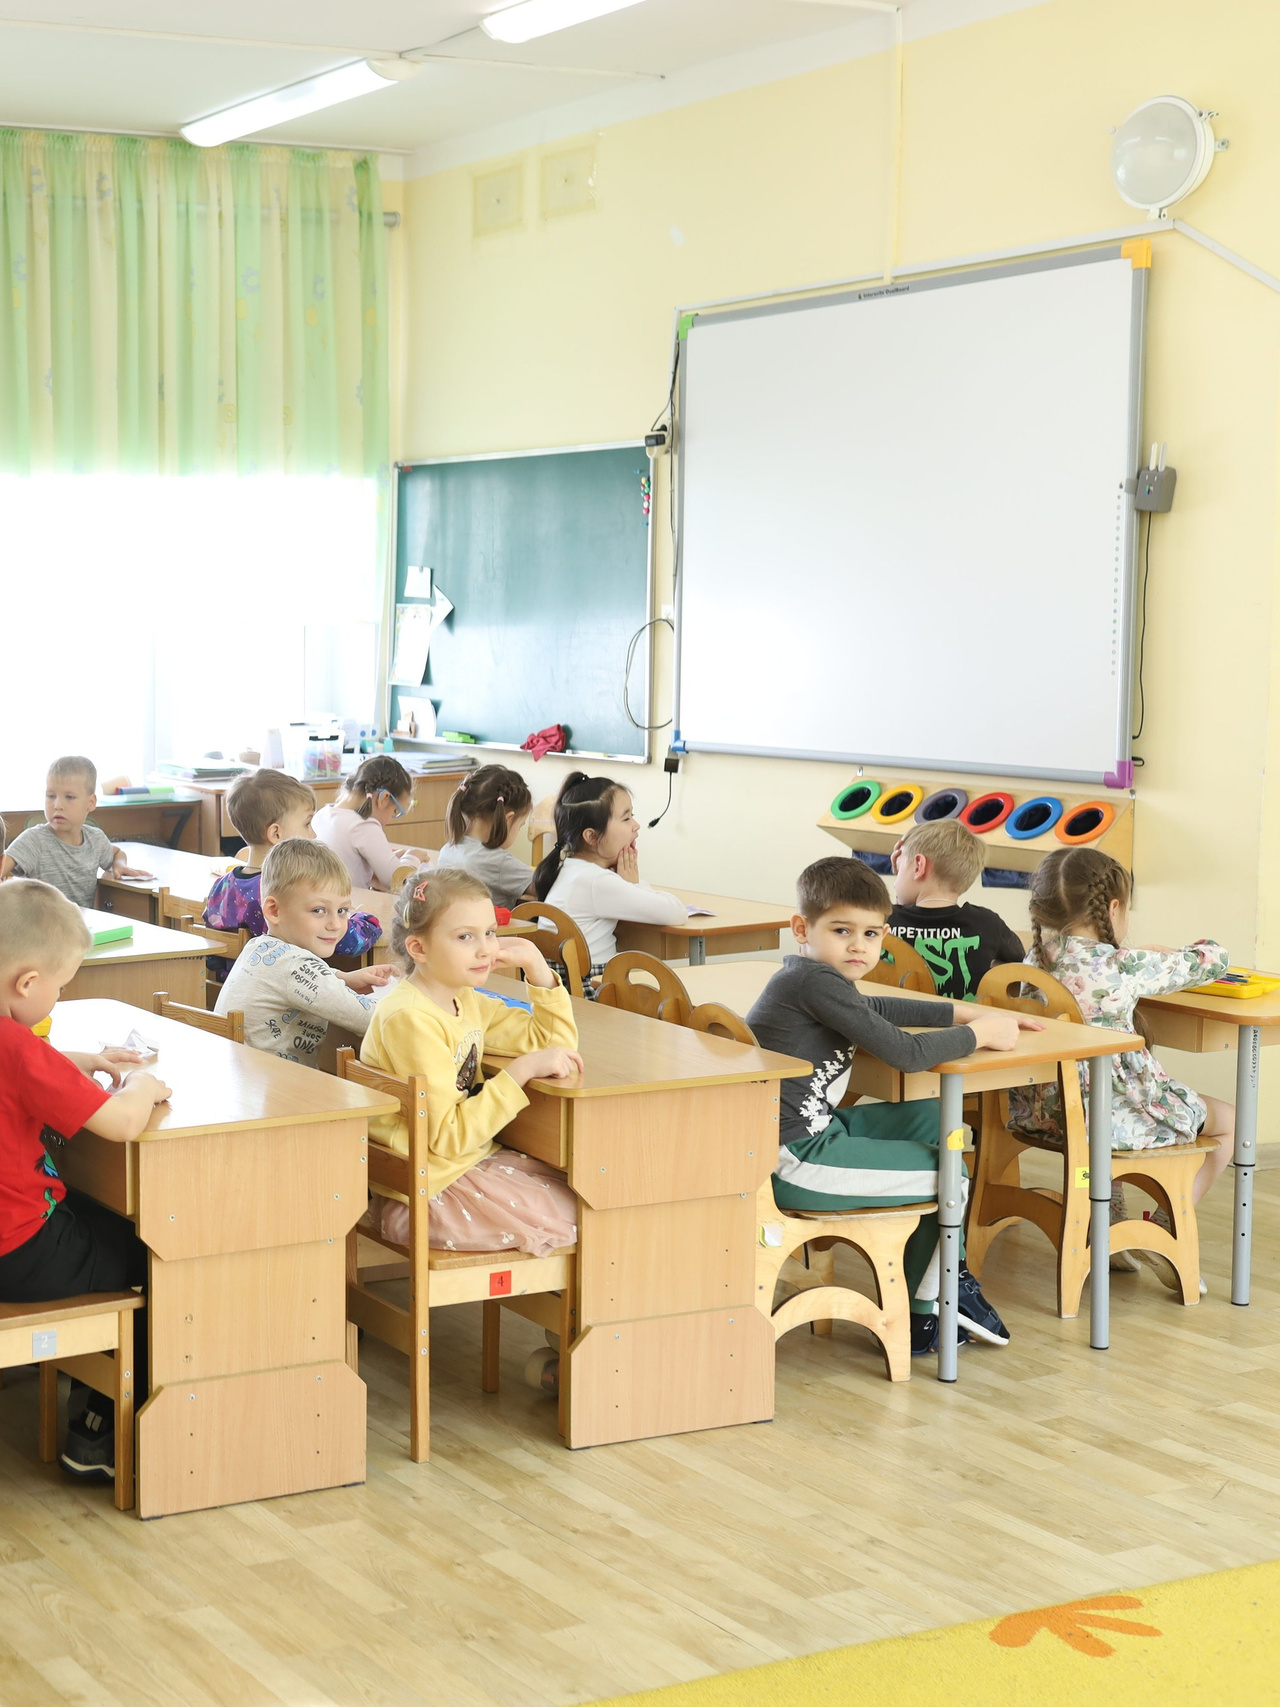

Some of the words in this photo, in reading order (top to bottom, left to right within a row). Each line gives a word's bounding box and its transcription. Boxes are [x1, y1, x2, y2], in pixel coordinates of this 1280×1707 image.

[887, 926, 961, 939] MPETITION
[299, 963, 319, 981] SOME
[497, 1275, 504, 1287] 4
[40, 1335, 48, 1348] 2
